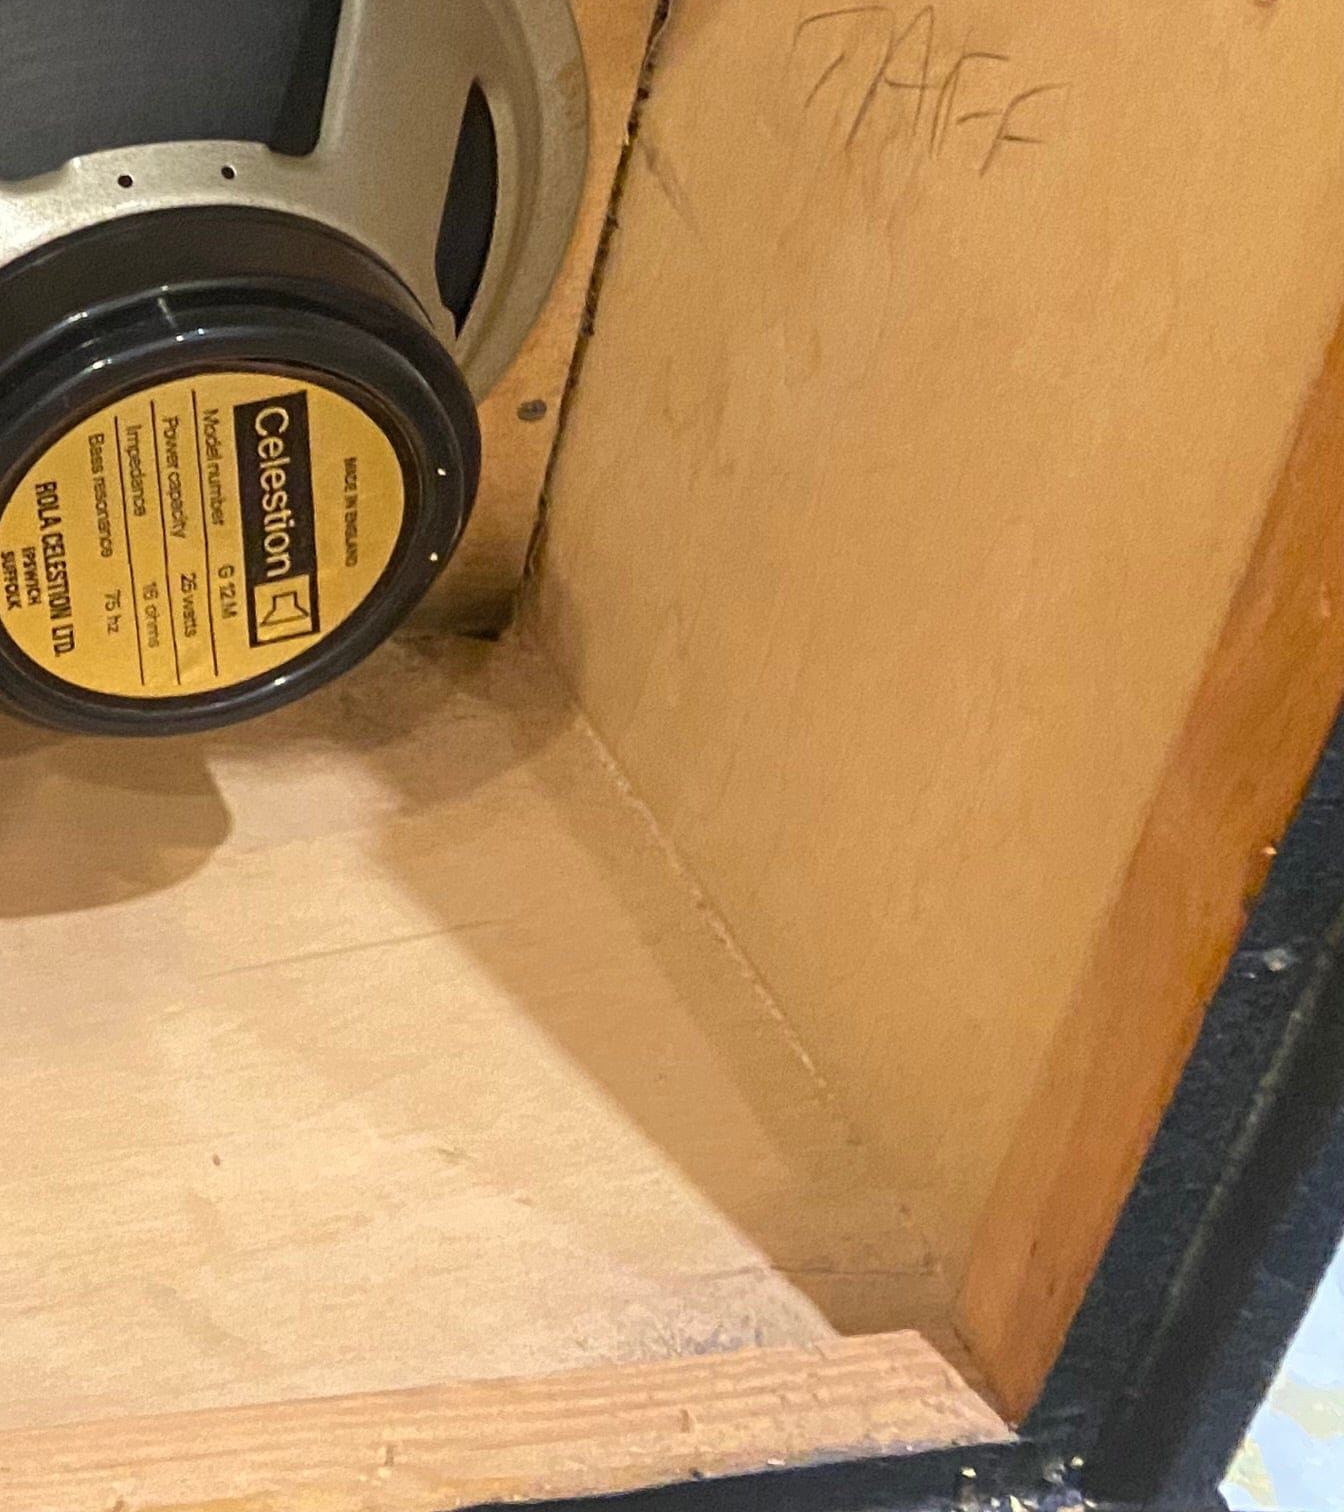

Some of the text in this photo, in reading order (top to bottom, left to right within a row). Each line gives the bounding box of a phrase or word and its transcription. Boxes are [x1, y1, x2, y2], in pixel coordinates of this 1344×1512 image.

[88, 432, 105, 474] Bass
[163, 416, 179, 469] Power
[202, 408, 223, 461] Model
[126, 424, 146, 517] Impedance
[207, 463, 224, 526] number
[255, 407, 296, 577] Celestion
[35, 481, 61, 531] ROLA
[93, 476, 113, 558] resonance
[167, 472, 189, 538] capacity
[0, 551, 22, 611] SUFFOLK
[22, 546, 42, 607] IPSWICH
[41, 533, 72, 621] CELESTION
